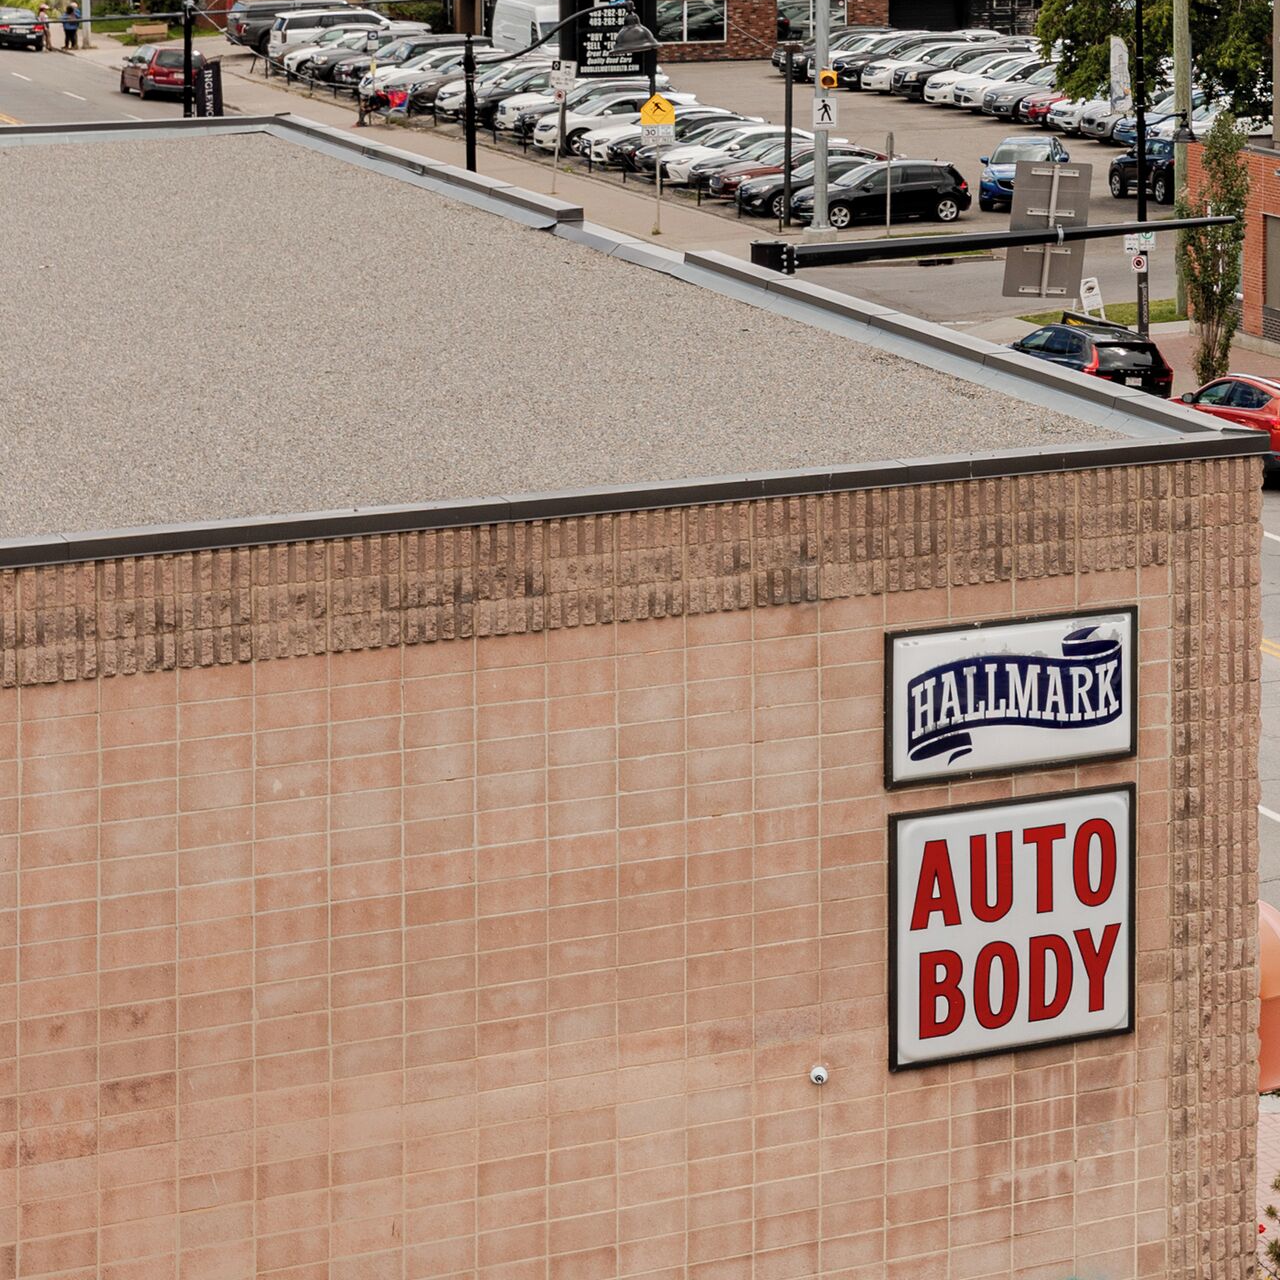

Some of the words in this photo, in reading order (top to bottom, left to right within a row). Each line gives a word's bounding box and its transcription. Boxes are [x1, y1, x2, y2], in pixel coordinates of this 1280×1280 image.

[203, 70, 215, 117] INGLEWO
[645, 129, 657, 137] 30
[911, 659, 1120, 740] HALLMARK
[909, 817, 1118, 932] AUTO
[918, 922, 1122, 1041] BODY
